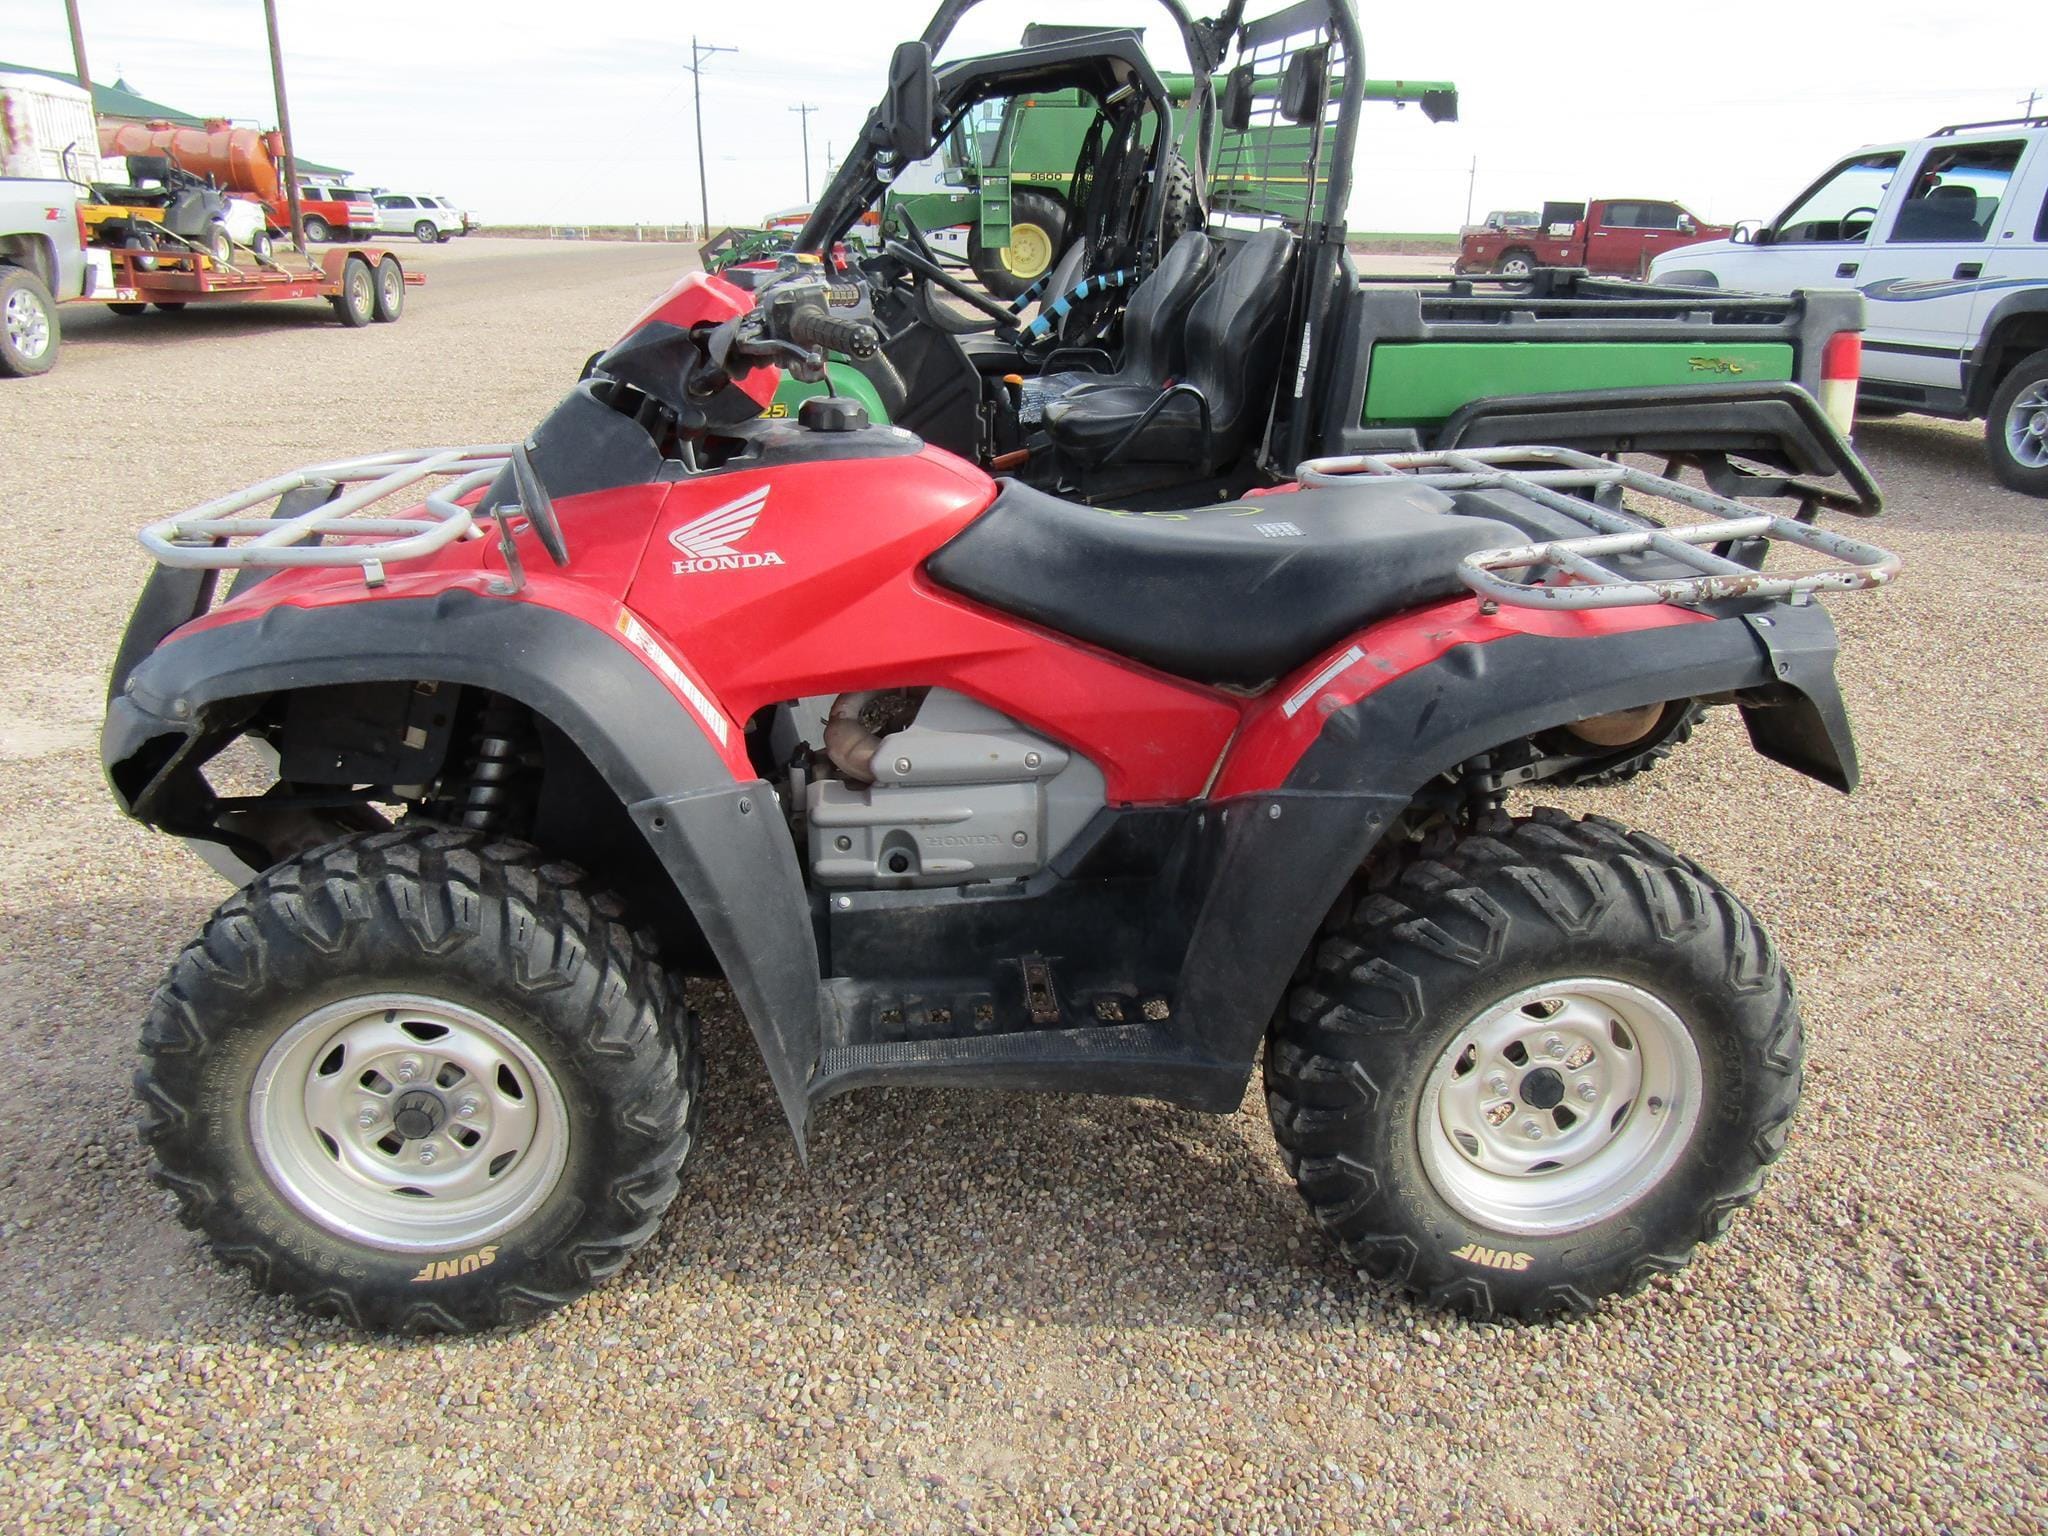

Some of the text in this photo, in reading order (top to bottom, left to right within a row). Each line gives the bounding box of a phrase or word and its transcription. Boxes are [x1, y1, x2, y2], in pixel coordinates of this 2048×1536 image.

[1030, 173, 1062, 181] 9600
[672, 551, 785, 575] HONDA
[925, 834, 1002, 848] HONDA
[410, 1245, 501, 1283] SUNF
[1449, 1243, 1536, 1271] SUNF
